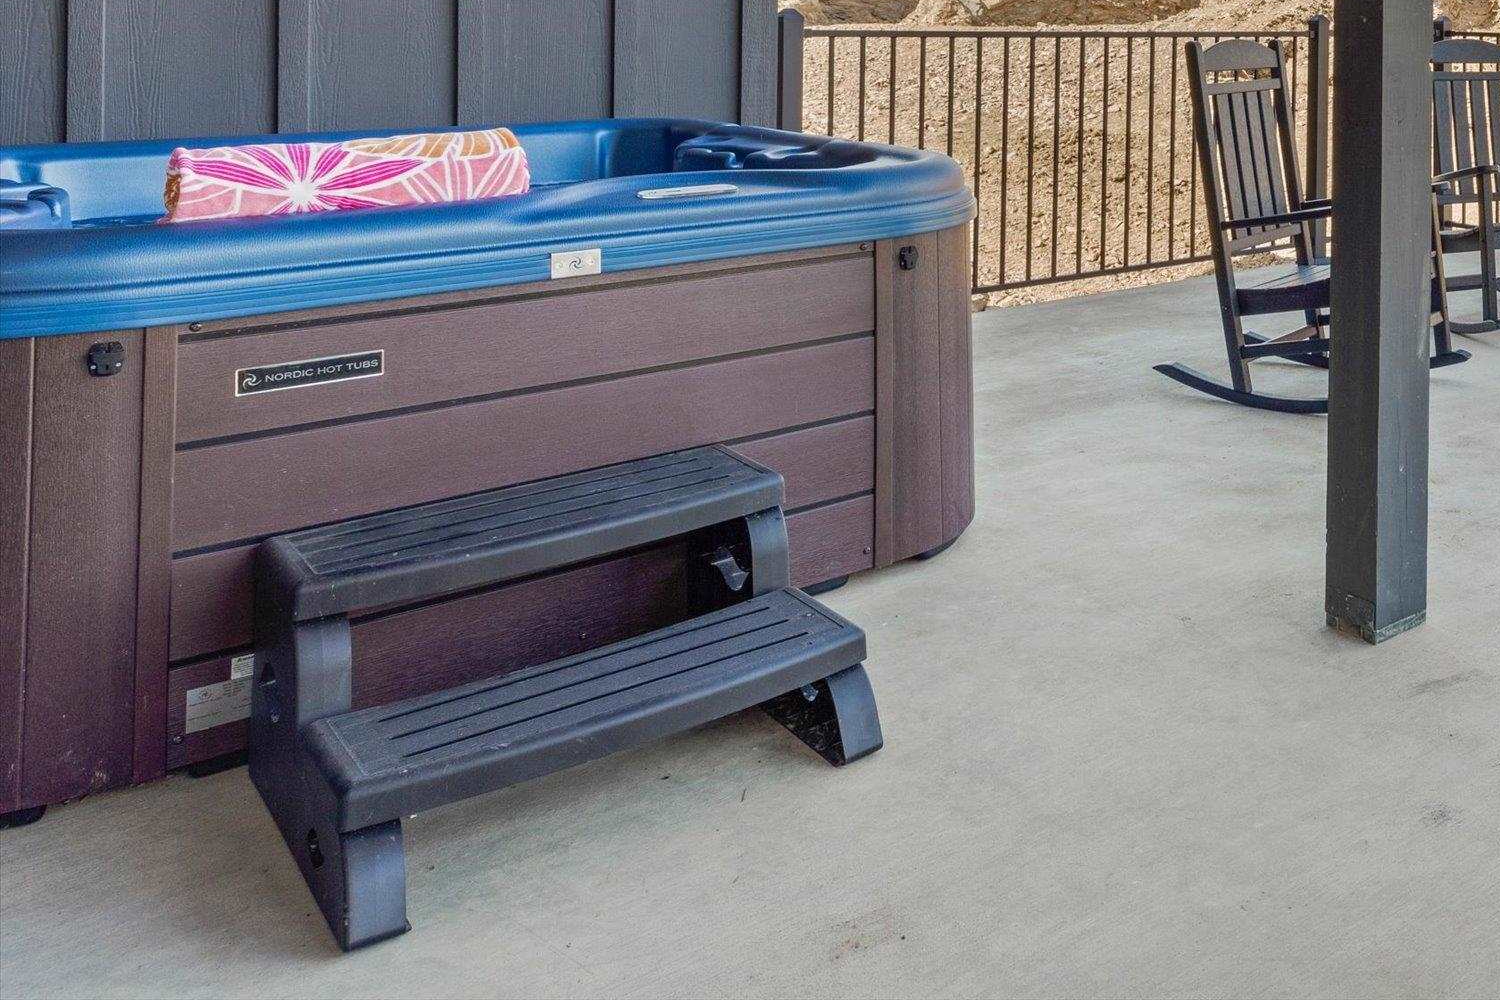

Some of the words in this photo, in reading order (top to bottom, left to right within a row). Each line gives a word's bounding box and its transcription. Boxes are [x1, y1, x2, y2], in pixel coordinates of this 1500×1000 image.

[265, 368, 314, 383] NORDIC
[317, 364, 343, 375] HOT
[346, 358, 379, 370] TUBS
